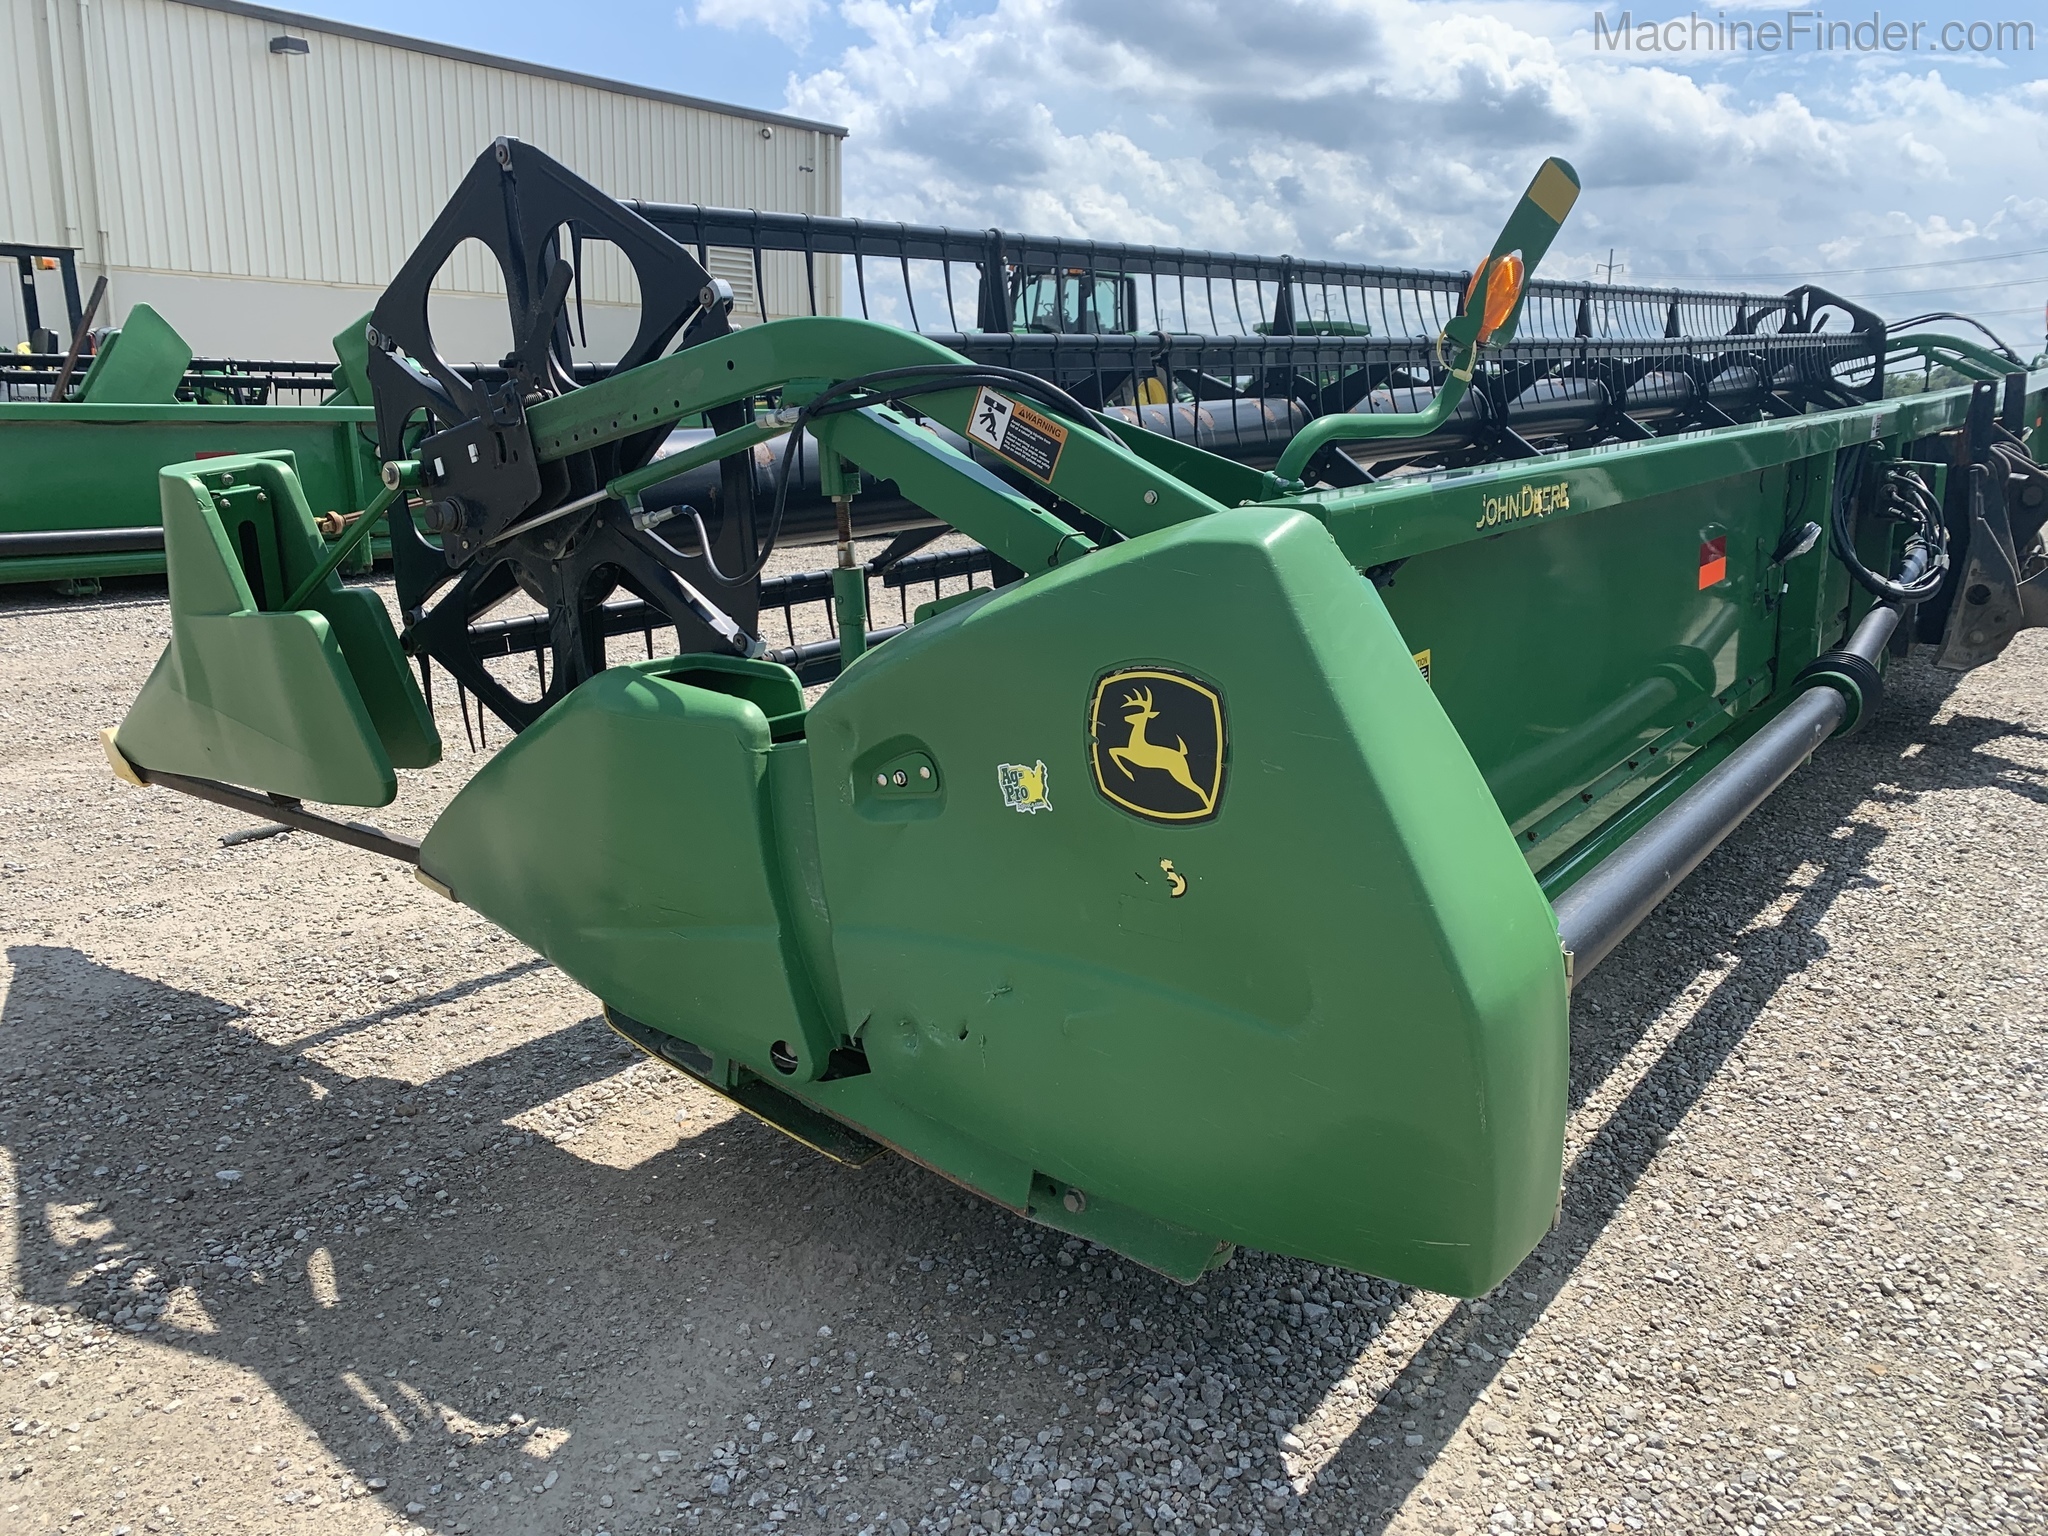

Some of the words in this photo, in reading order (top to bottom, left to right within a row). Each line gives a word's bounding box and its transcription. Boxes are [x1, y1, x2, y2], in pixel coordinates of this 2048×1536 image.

[1025, 411, 1062, 438] WARNING
[1476, 493, 1520, 528] JOHN
[1001, 768, 1023, 787] Ag-
[1005, 785, 1029, 802] Pro
